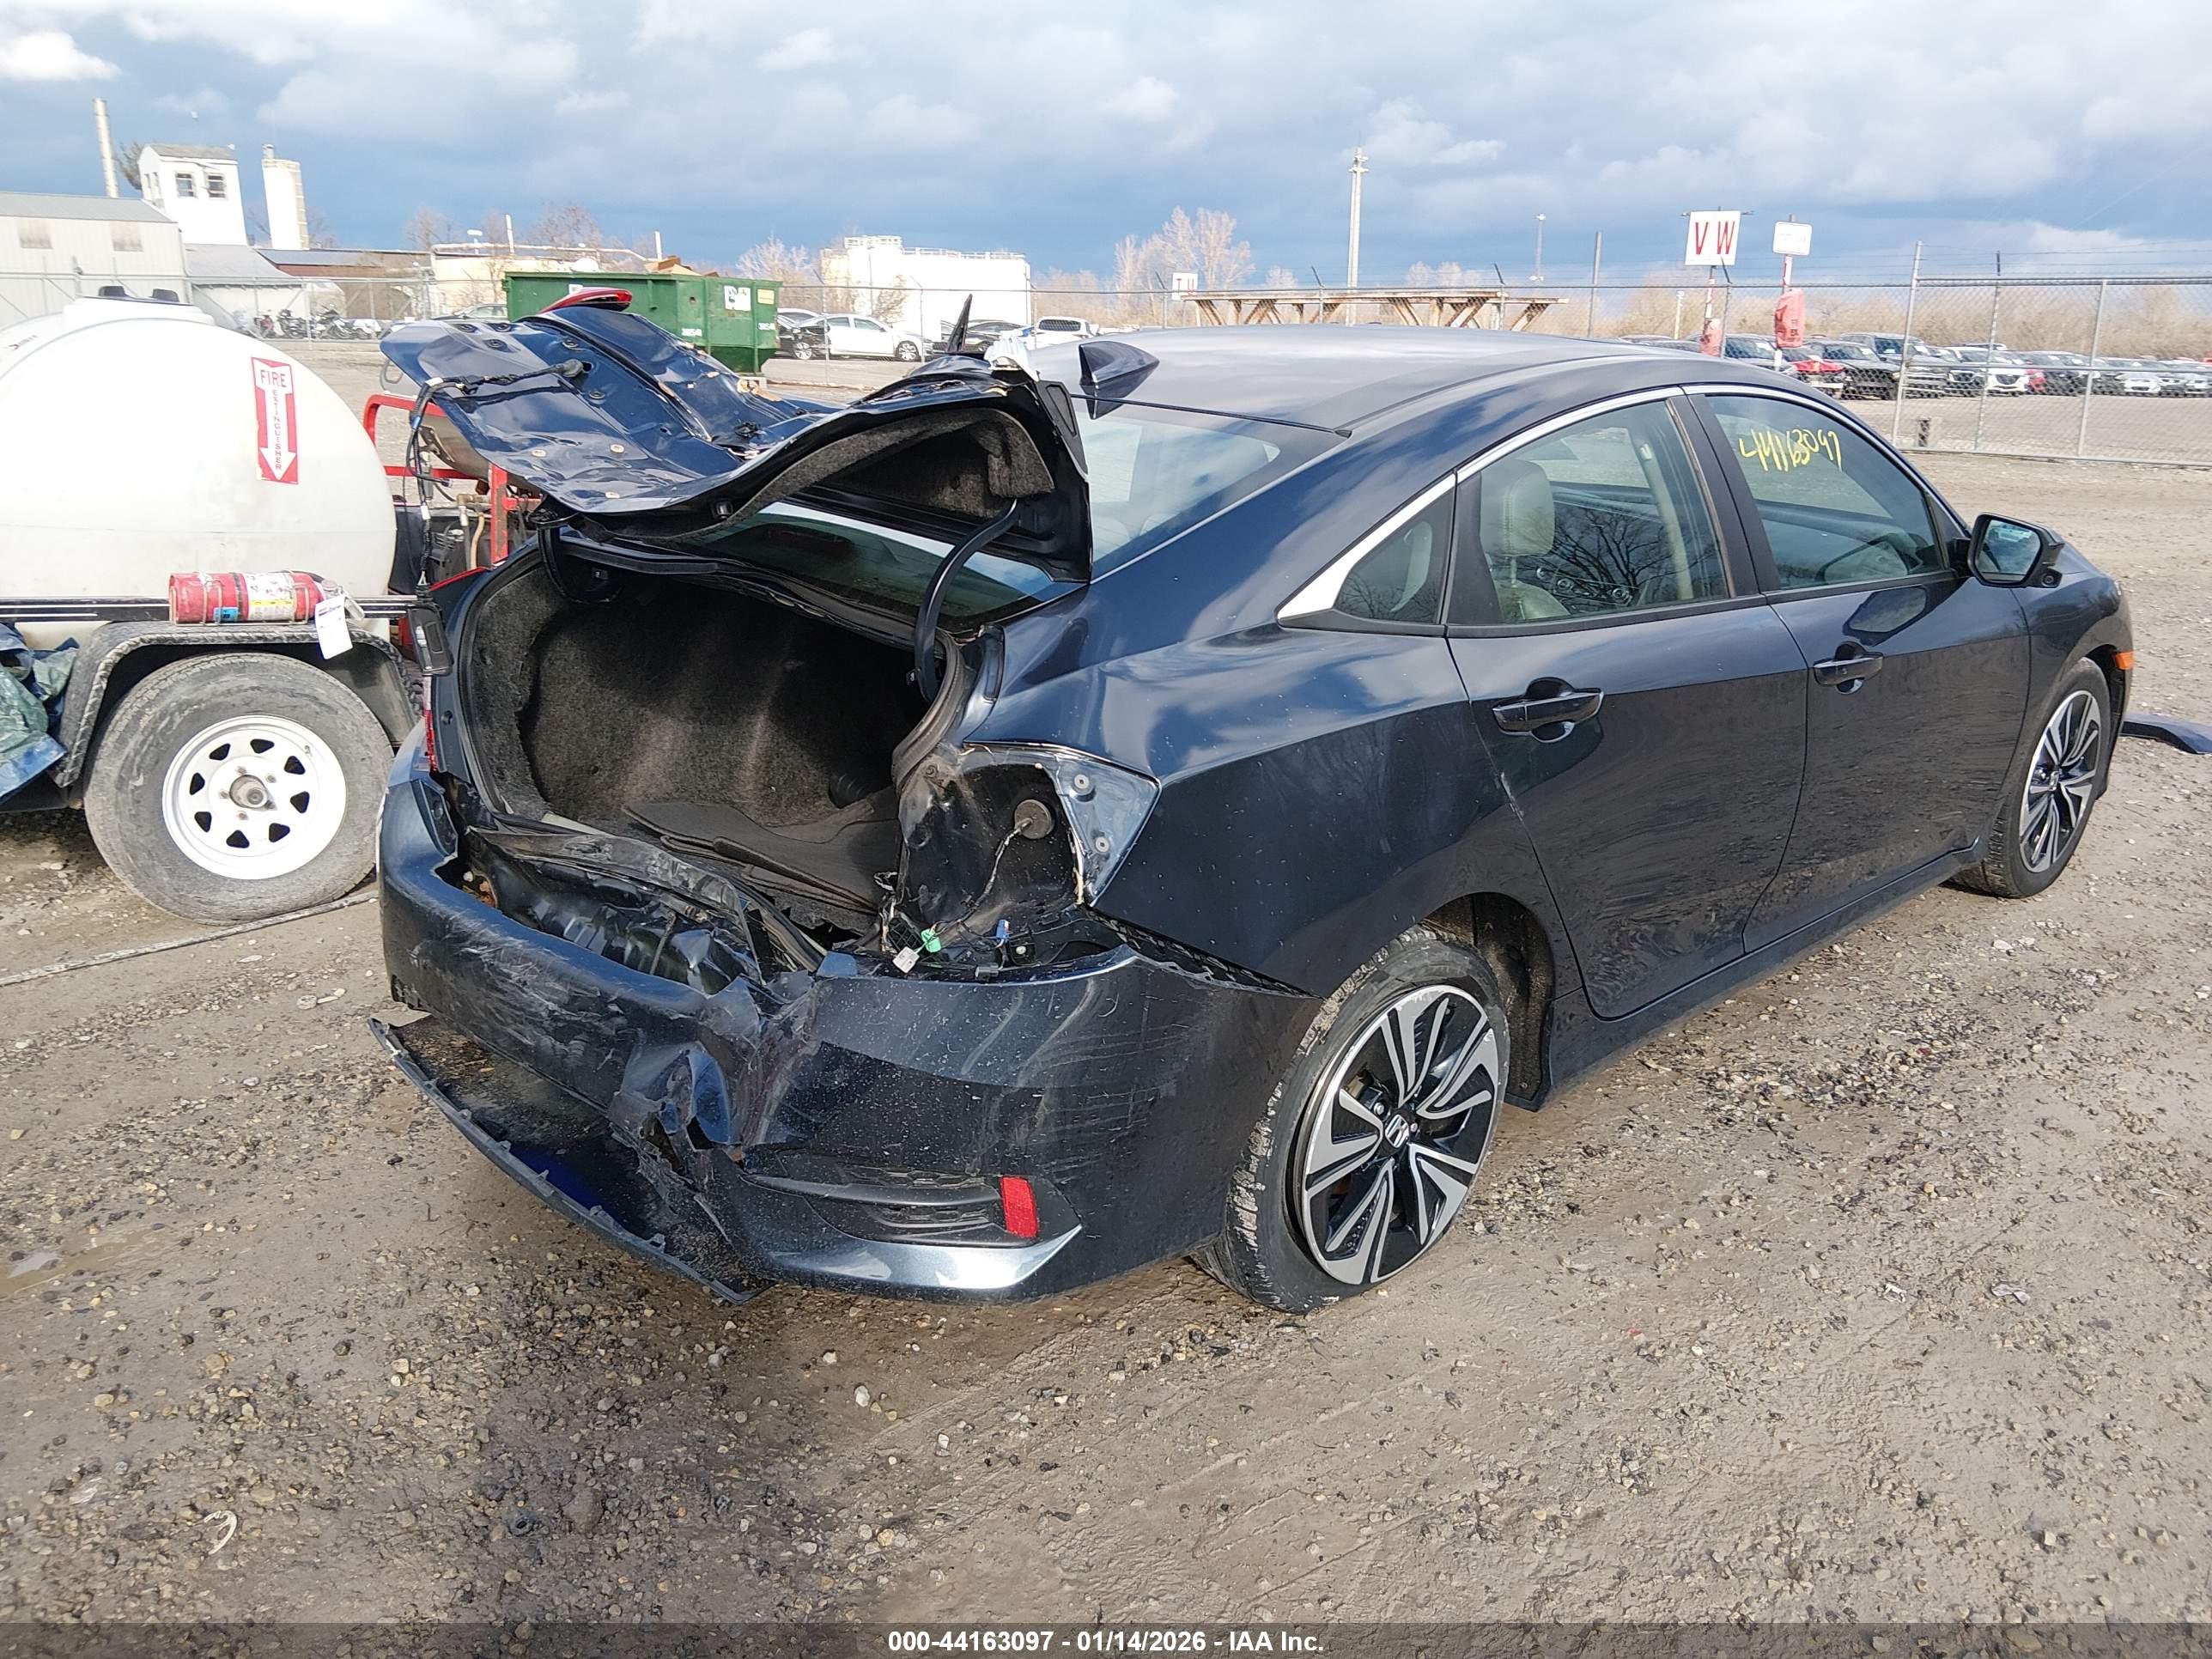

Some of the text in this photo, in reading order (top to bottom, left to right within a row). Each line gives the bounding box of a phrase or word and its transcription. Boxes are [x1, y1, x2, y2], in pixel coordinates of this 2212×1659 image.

[260, 369, 287, 388] FIRE
[272, 389, 282, 471] EXTINGUISHER
[1738, 428, 1843, 472] 44163097
